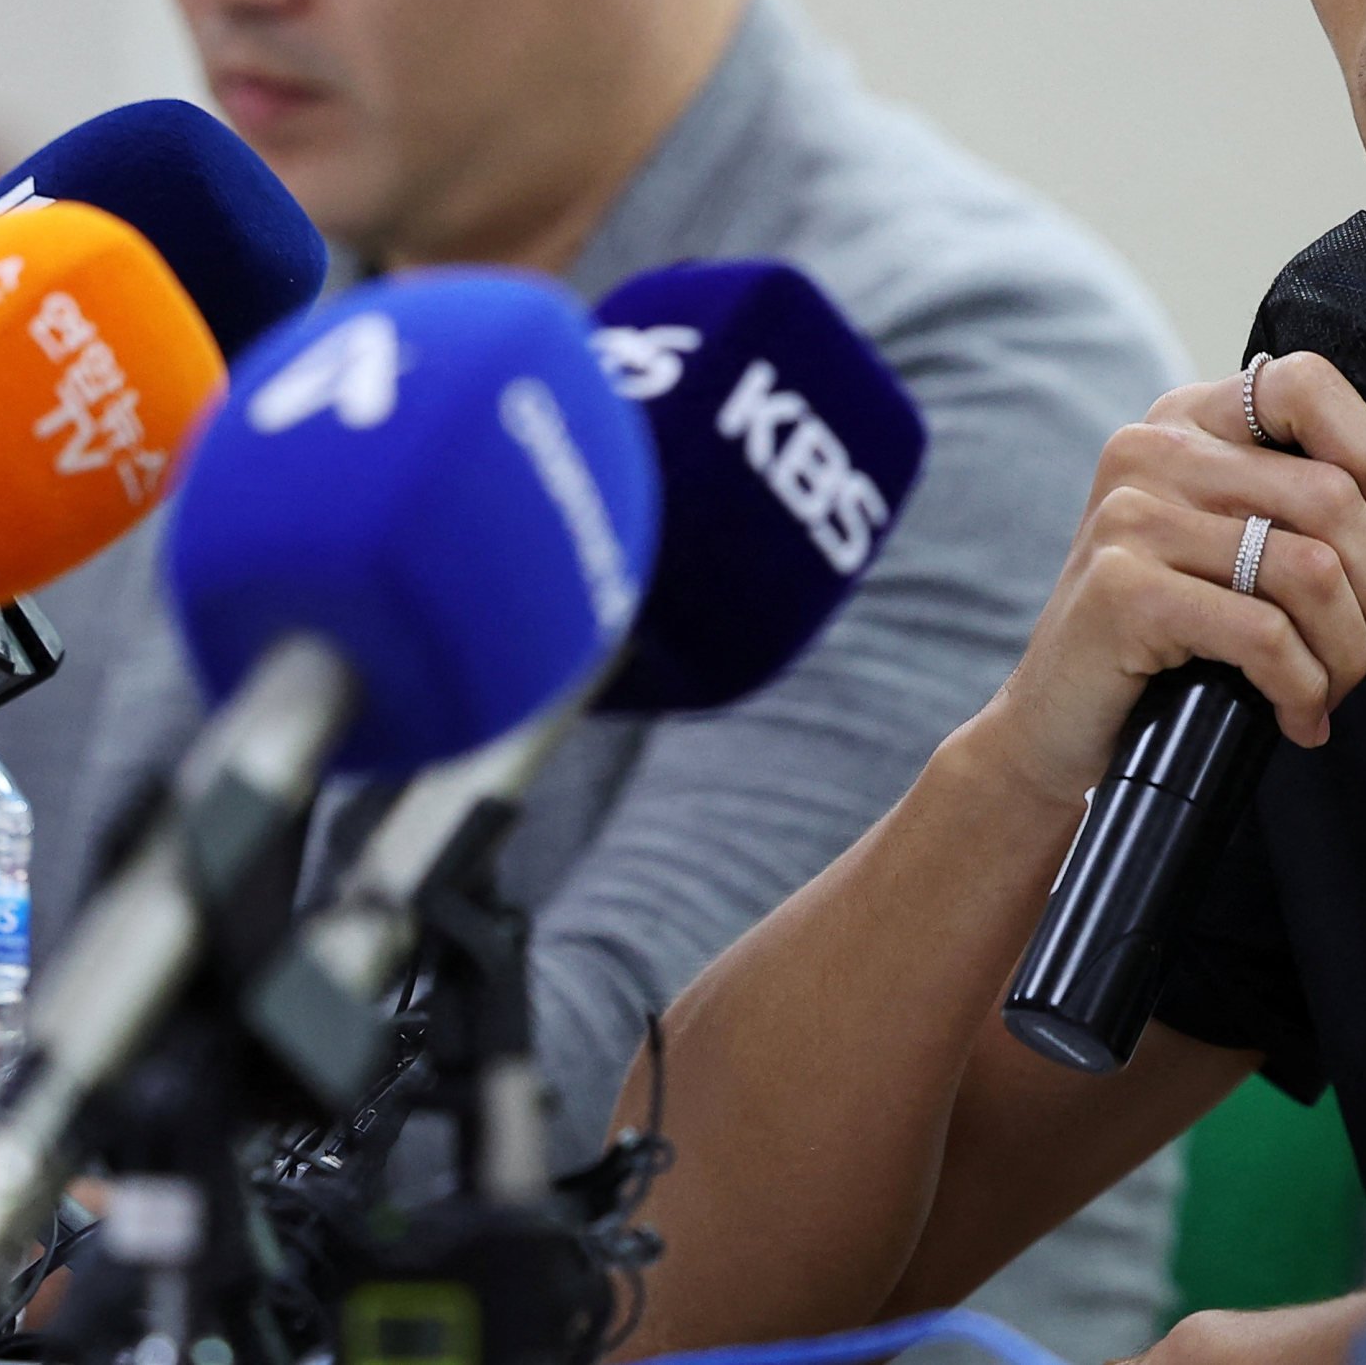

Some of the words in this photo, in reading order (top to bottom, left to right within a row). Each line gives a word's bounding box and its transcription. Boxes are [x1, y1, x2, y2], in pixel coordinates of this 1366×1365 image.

[586, 325, 703, 401] BS
[31, 380, 115, 477] TV
[716, 360, 890, 575] KBS
